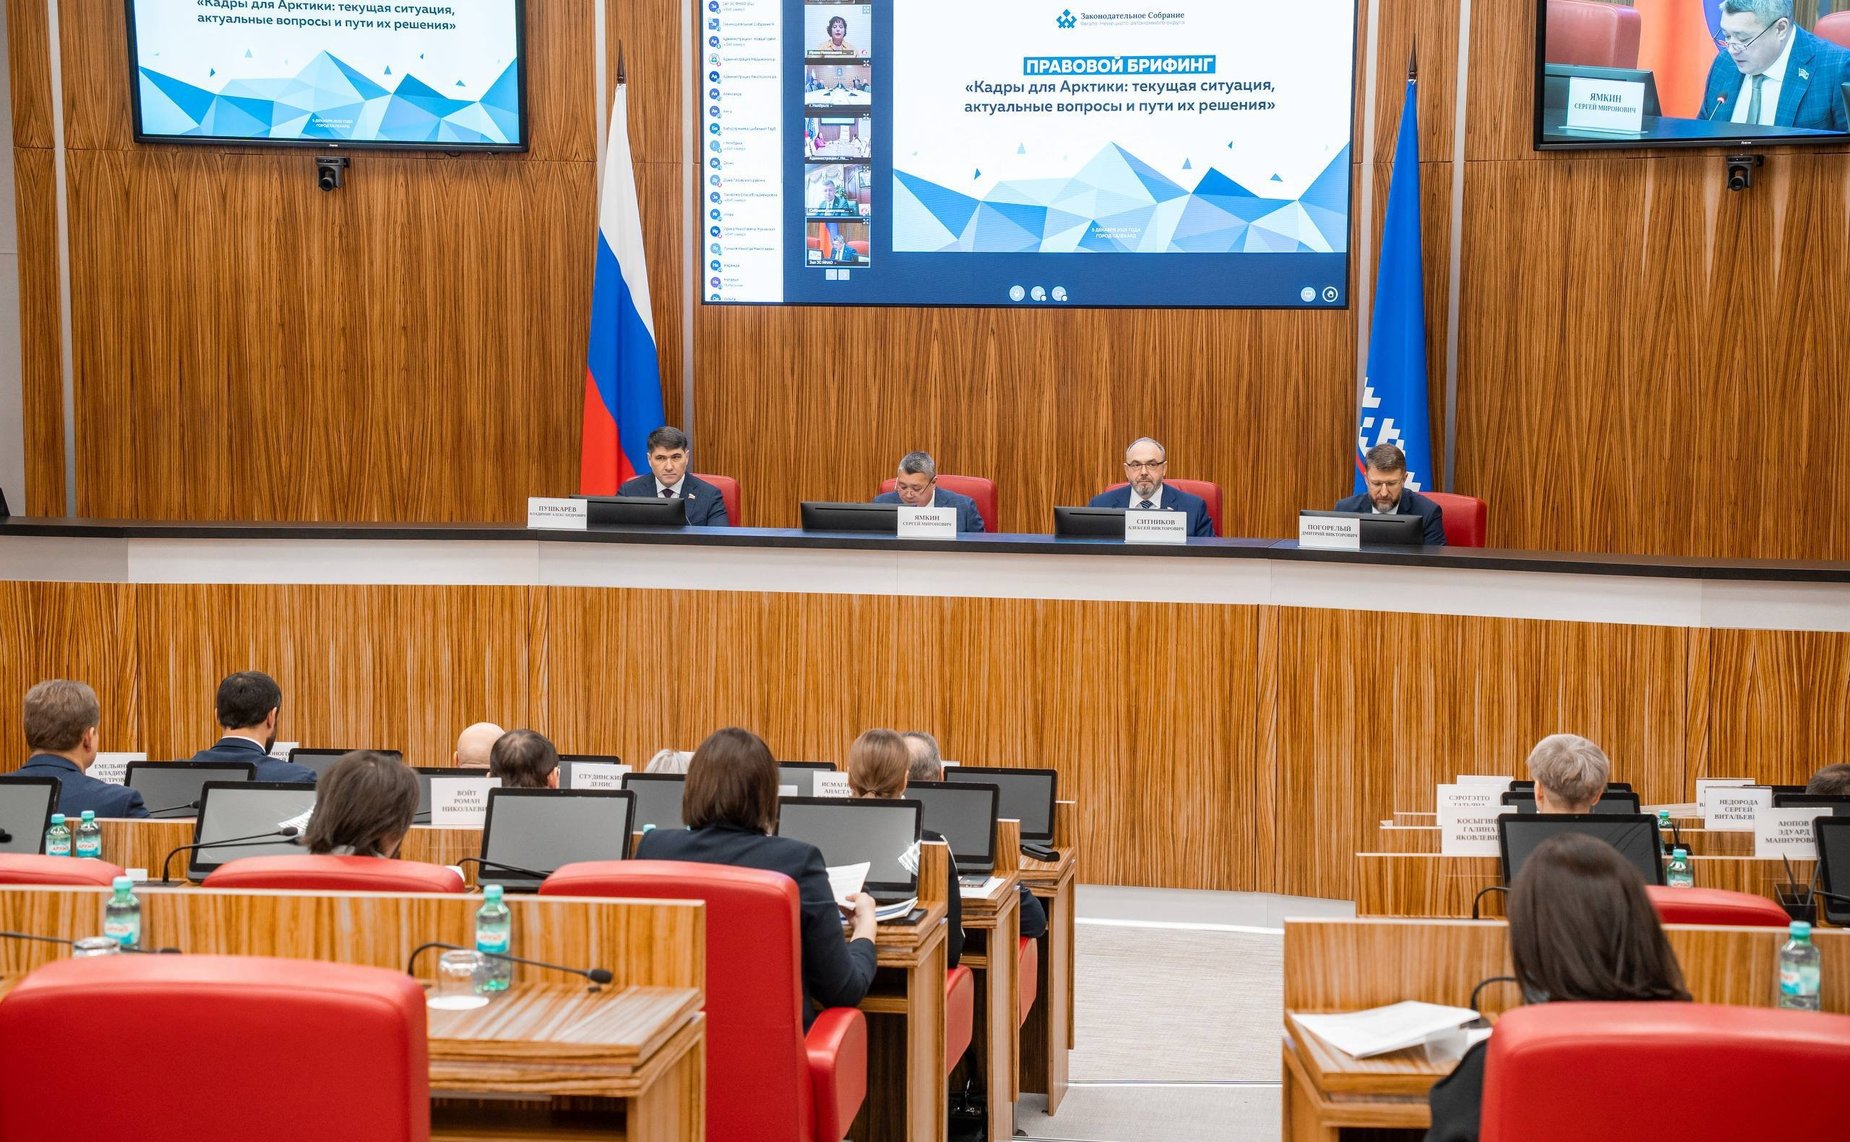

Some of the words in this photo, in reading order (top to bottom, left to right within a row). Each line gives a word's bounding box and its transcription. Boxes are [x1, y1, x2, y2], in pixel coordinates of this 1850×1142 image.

[251, 0, 275, 10] для
[278, 0, 335, 12] Арктики:
[338, 3, 391, 14] текущая
[395, 6, 455, 16] ситуация,
[1080, 12, 1147, 20] Законодательное
[1148, 11, 1185, 20] Собрание
[197, 14, 273, 26] актуальные
[276, 17, 332, 28] вопросы
[335, 19, 342, 27] и
[345, 20, 374, 30] пути
[377, 20, 392, 28] их
[395, 21, 456, 32] решения»
[1026, 56, 1125, 74] ПРАВОВОЙ
[1127, 57, 1214, 73] БРИФИНГ
[965, 80, 1025, 96] «Кадры
[1028, 83, 1056, 94] для
[1060, 80, 1128, 95] Арктики:
[1132, 82, 1196, 95] текущая
[1200, 80, 1275, 94] ситуация,
[1590, 92, 1622, 103] ЯМКИН
[964, 102, 1053, 115] актуальные
[1056, 101, 1122, 115] вопросы
[1126, 101, 1135, 111] и
[1139, 101, 1174, 114] пути
[1178, 101, 1195, 111] их
[1199, 100, 1275, 114] решения»
[1574, 103, 1597, 112] СЕРГЕЙ
[1598, 104, 1637, 113] МИРОНОВИЧ
[1307, 524, 1352, 532] ПОГОРЕЛЫЙ
[456, 789, 477, 797] ВОЙТ
[1724, 805, 1753, 813] СЕРГЕЙ
